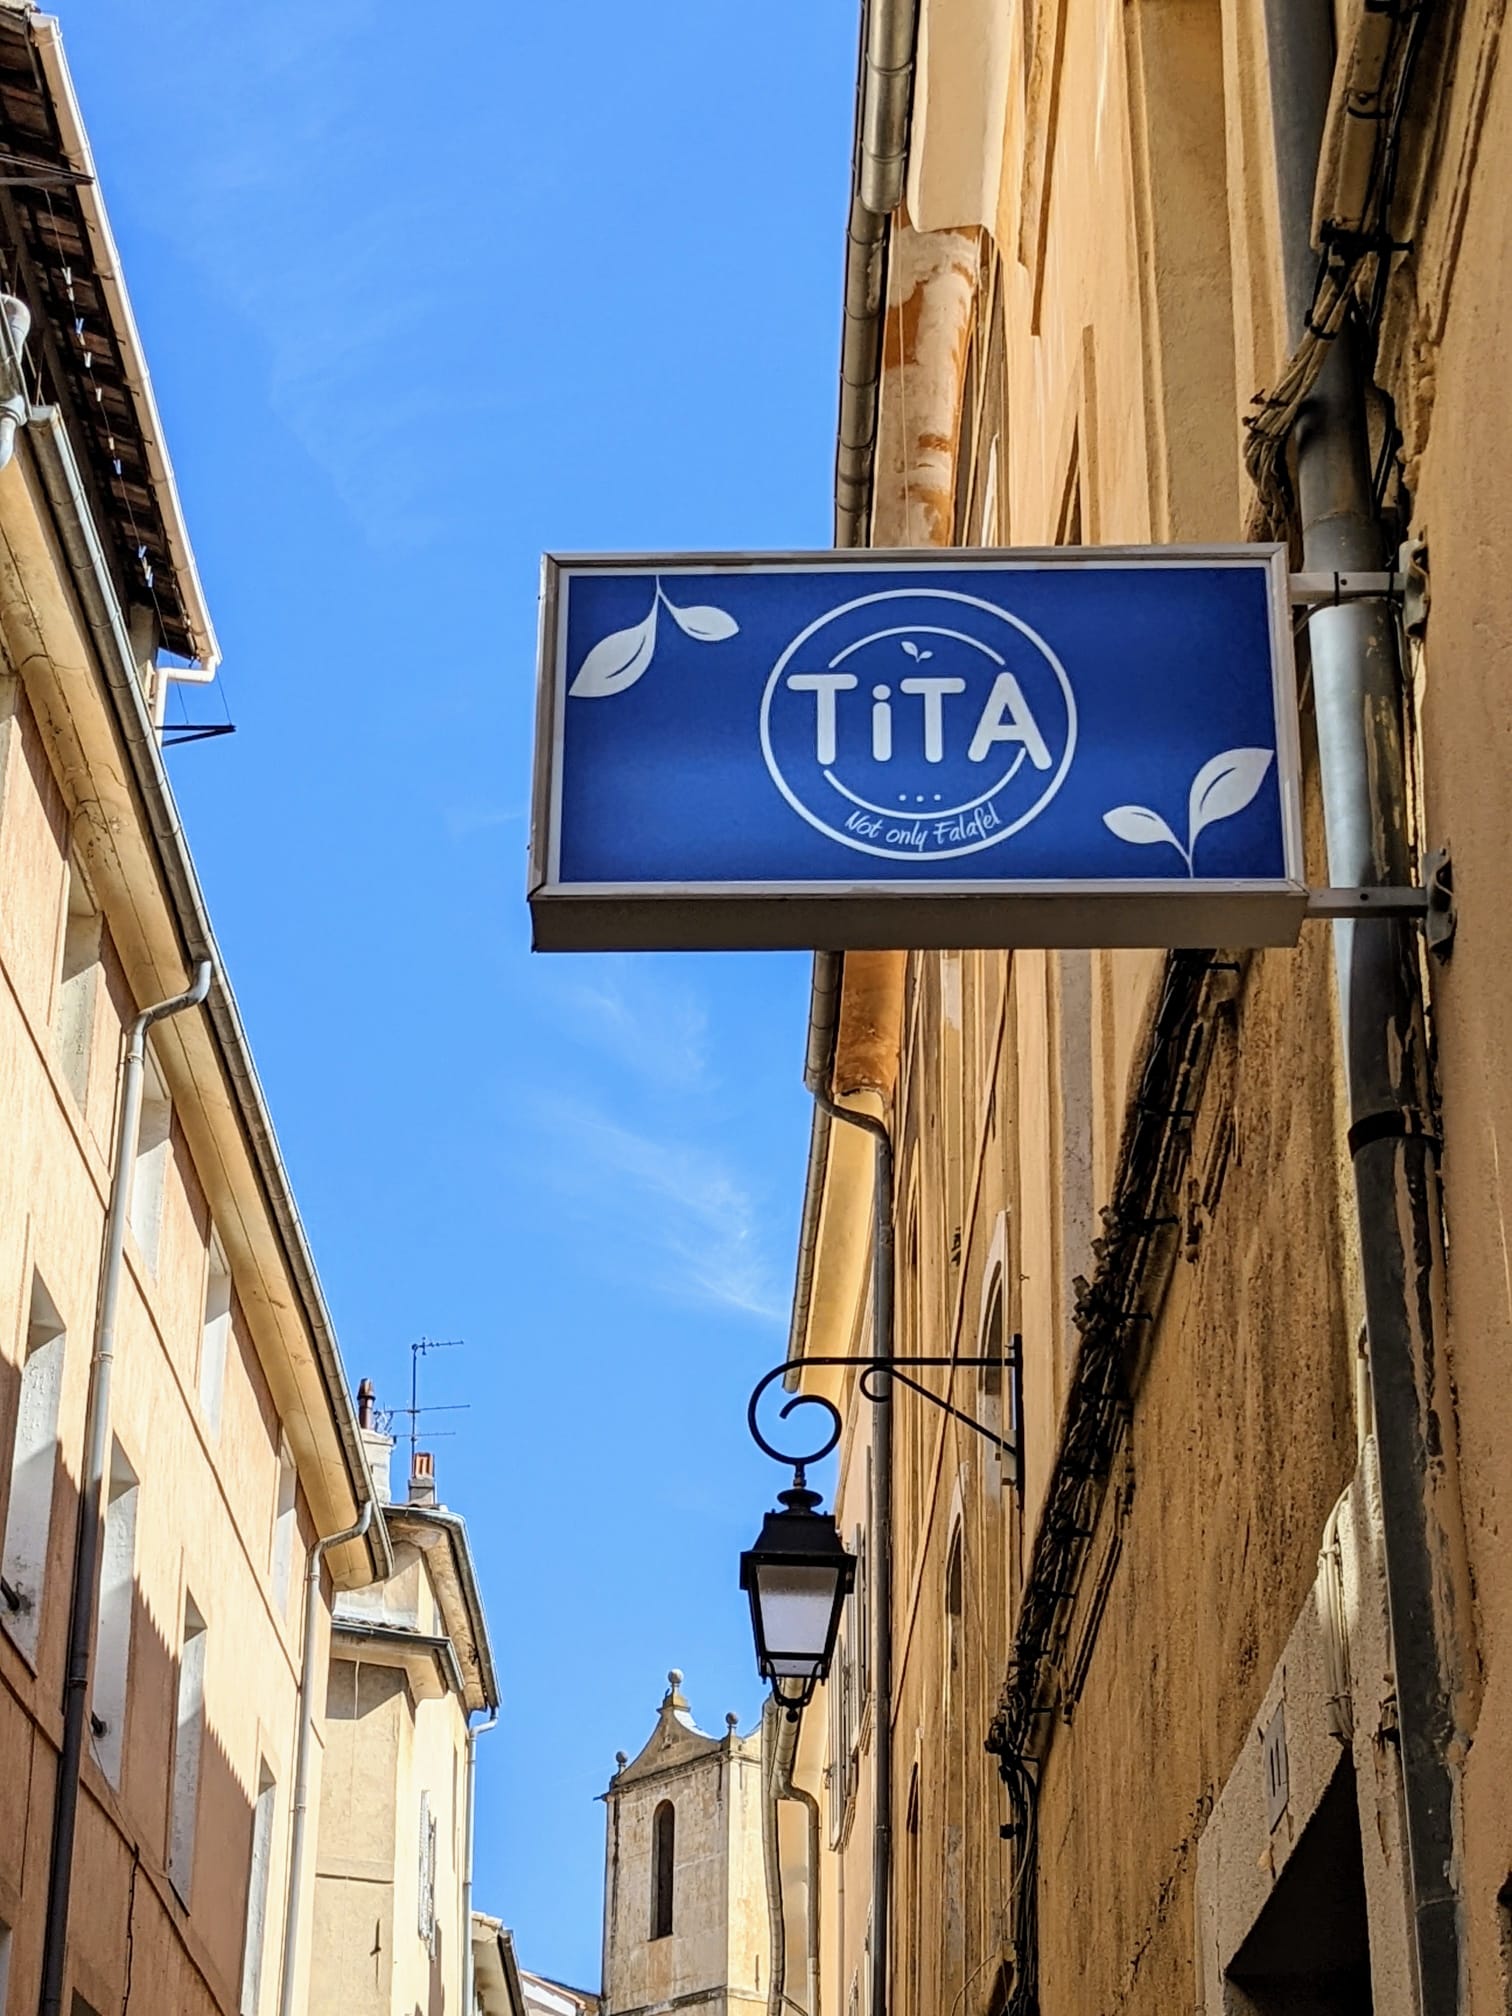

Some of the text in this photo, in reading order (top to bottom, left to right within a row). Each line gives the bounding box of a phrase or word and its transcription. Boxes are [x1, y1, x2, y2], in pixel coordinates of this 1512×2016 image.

[787, 672, 1052, 770] TiTA
[845, 801, 1001, 852] Not only Falafel
